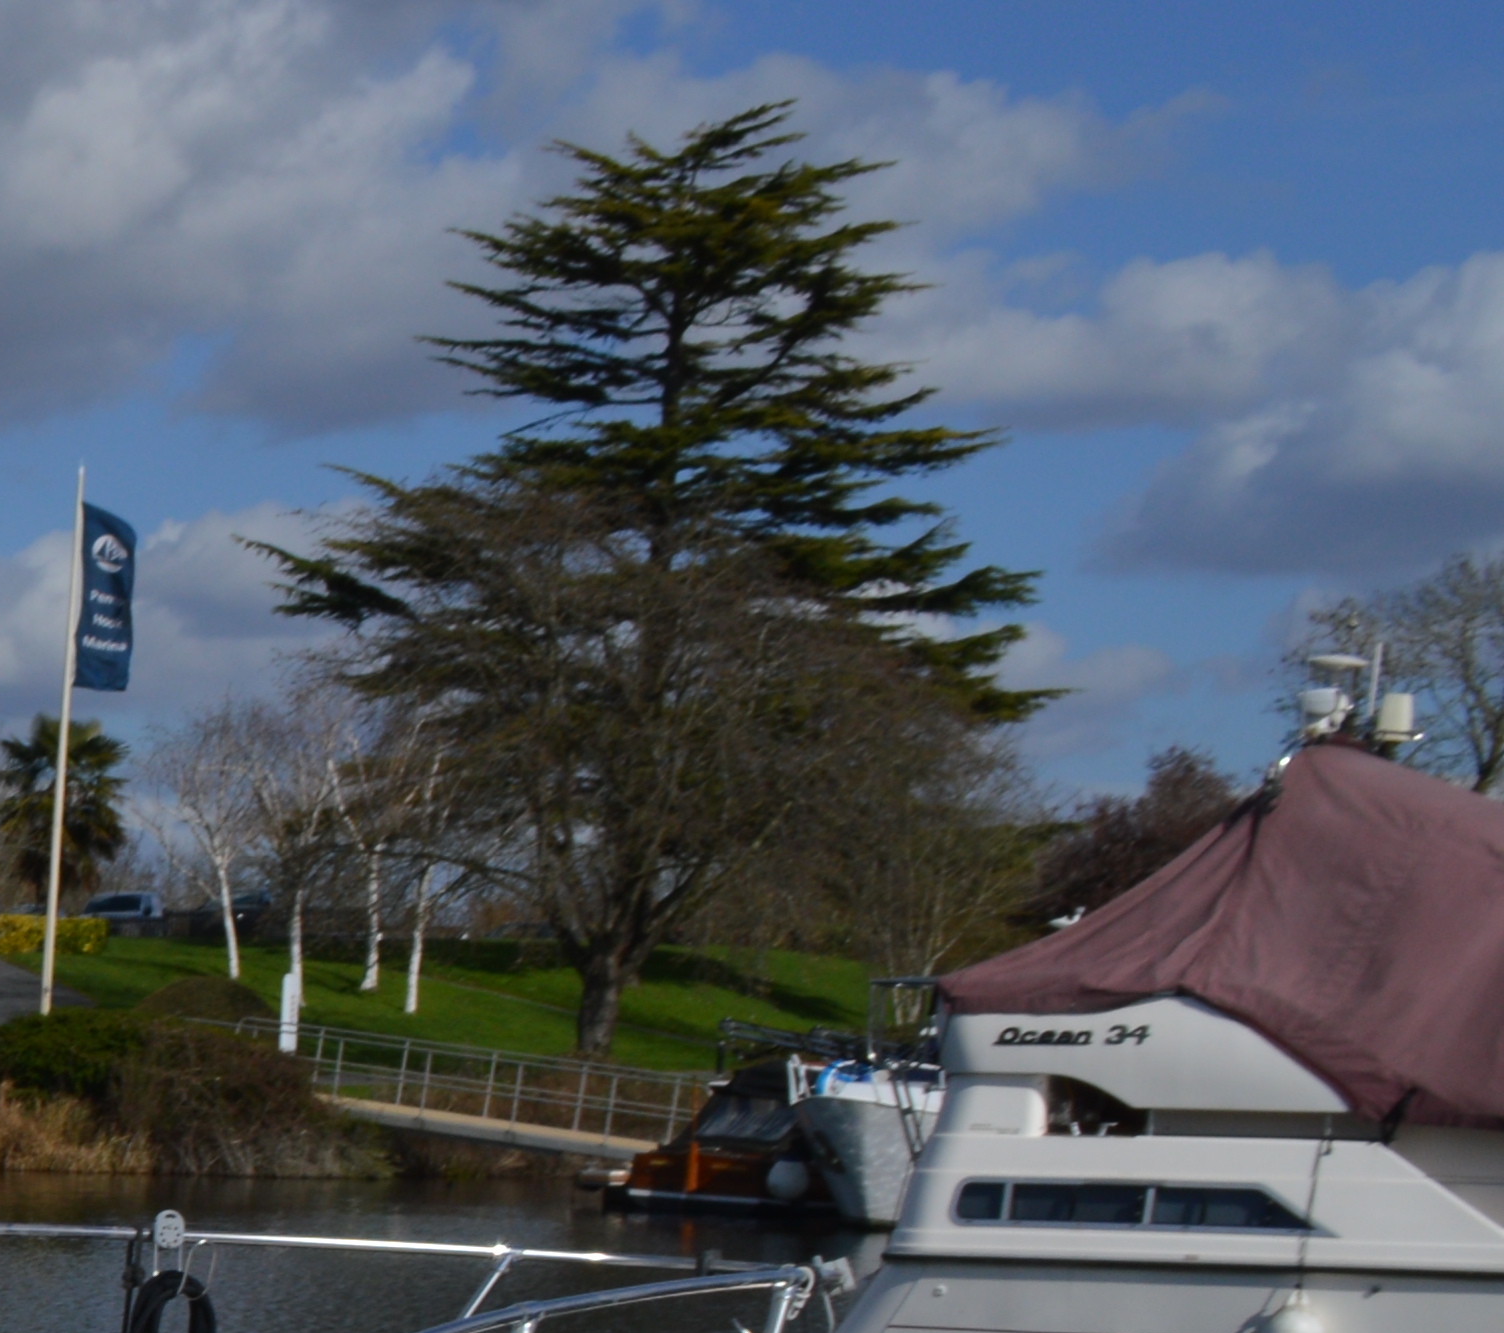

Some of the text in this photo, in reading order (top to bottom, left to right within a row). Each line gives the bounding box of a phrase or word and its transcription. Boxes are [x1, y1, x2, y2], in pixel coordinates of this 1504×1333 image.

[82, 634, 128, 652] Marina
[993, 1025, 1149, 1045] Ocean 34
